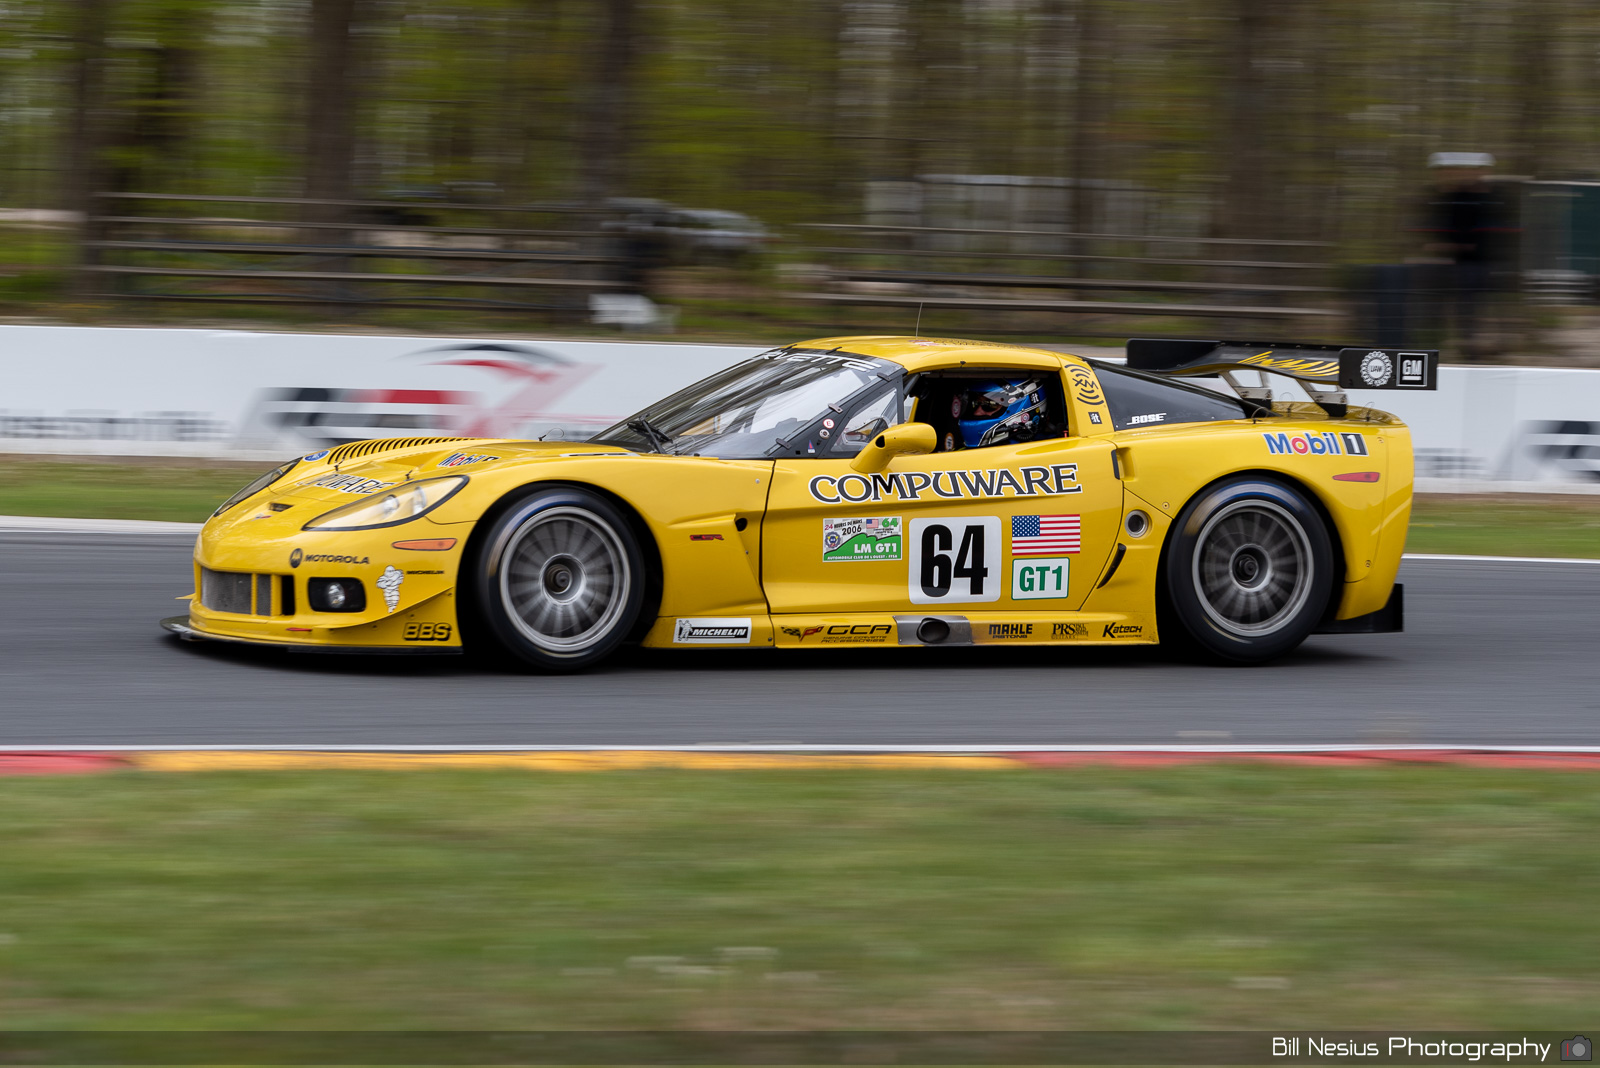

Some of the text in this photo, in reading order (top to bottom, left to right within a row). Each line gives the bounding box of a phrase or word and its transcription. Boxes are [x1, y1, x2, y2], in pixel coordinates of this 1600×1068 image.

[1402, 360, 1423, 376] GM
[1126, 412, 1167, 426] BOSE
[1263, 432, 1362, 455] Mobil 1
[809, 463, 1083, 504] COMPUWARE
[881, 517, 898, 528] 64
[841, 524, 862, 536] 2006
[854, 542, 897, 554] LM GT1
[303, 554, 370, 565] MOTOROLA
[920, 523, 988, 598] 64
[1019, 565, 1063, 592] GT1
[403, 622, 452, 641] BBS
[692, 628, 747, 636] MICHELIN
[827, 624, 893, 635] GCA
[988, 623, 1033, 635] MAHLE
[1052, 622, 1076, 636] PRS
